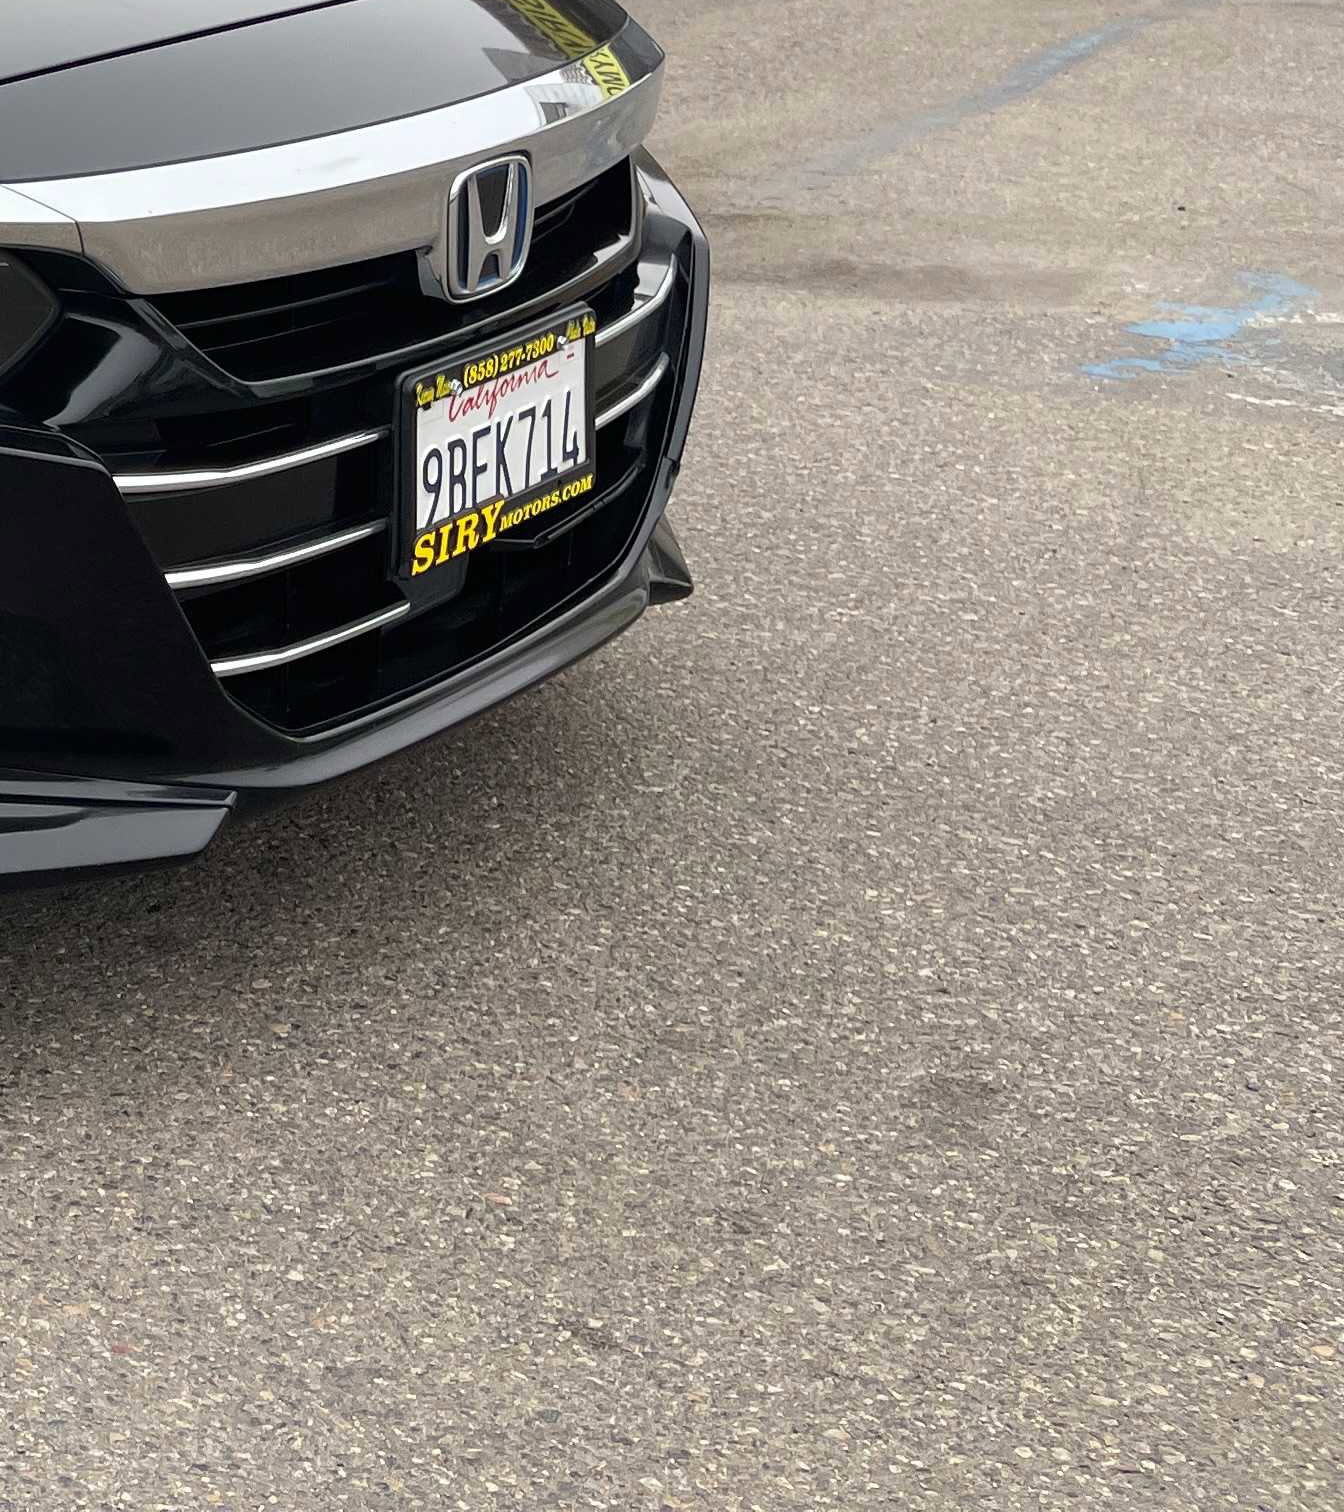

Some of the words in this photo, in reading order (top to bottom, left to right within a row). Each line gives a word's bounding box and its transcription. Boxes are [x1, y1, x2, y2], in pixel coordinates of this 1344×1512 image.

[448, 359, 560, 423] California
[463, 354, 499, 389] (858)
[499, 333, 555, 373] 277-7300
[422, 389, 580, 528] 9BFK714
[412, 499, 505, 576] SIRY
[499, 474, 594, 532] MOTORS.COM
